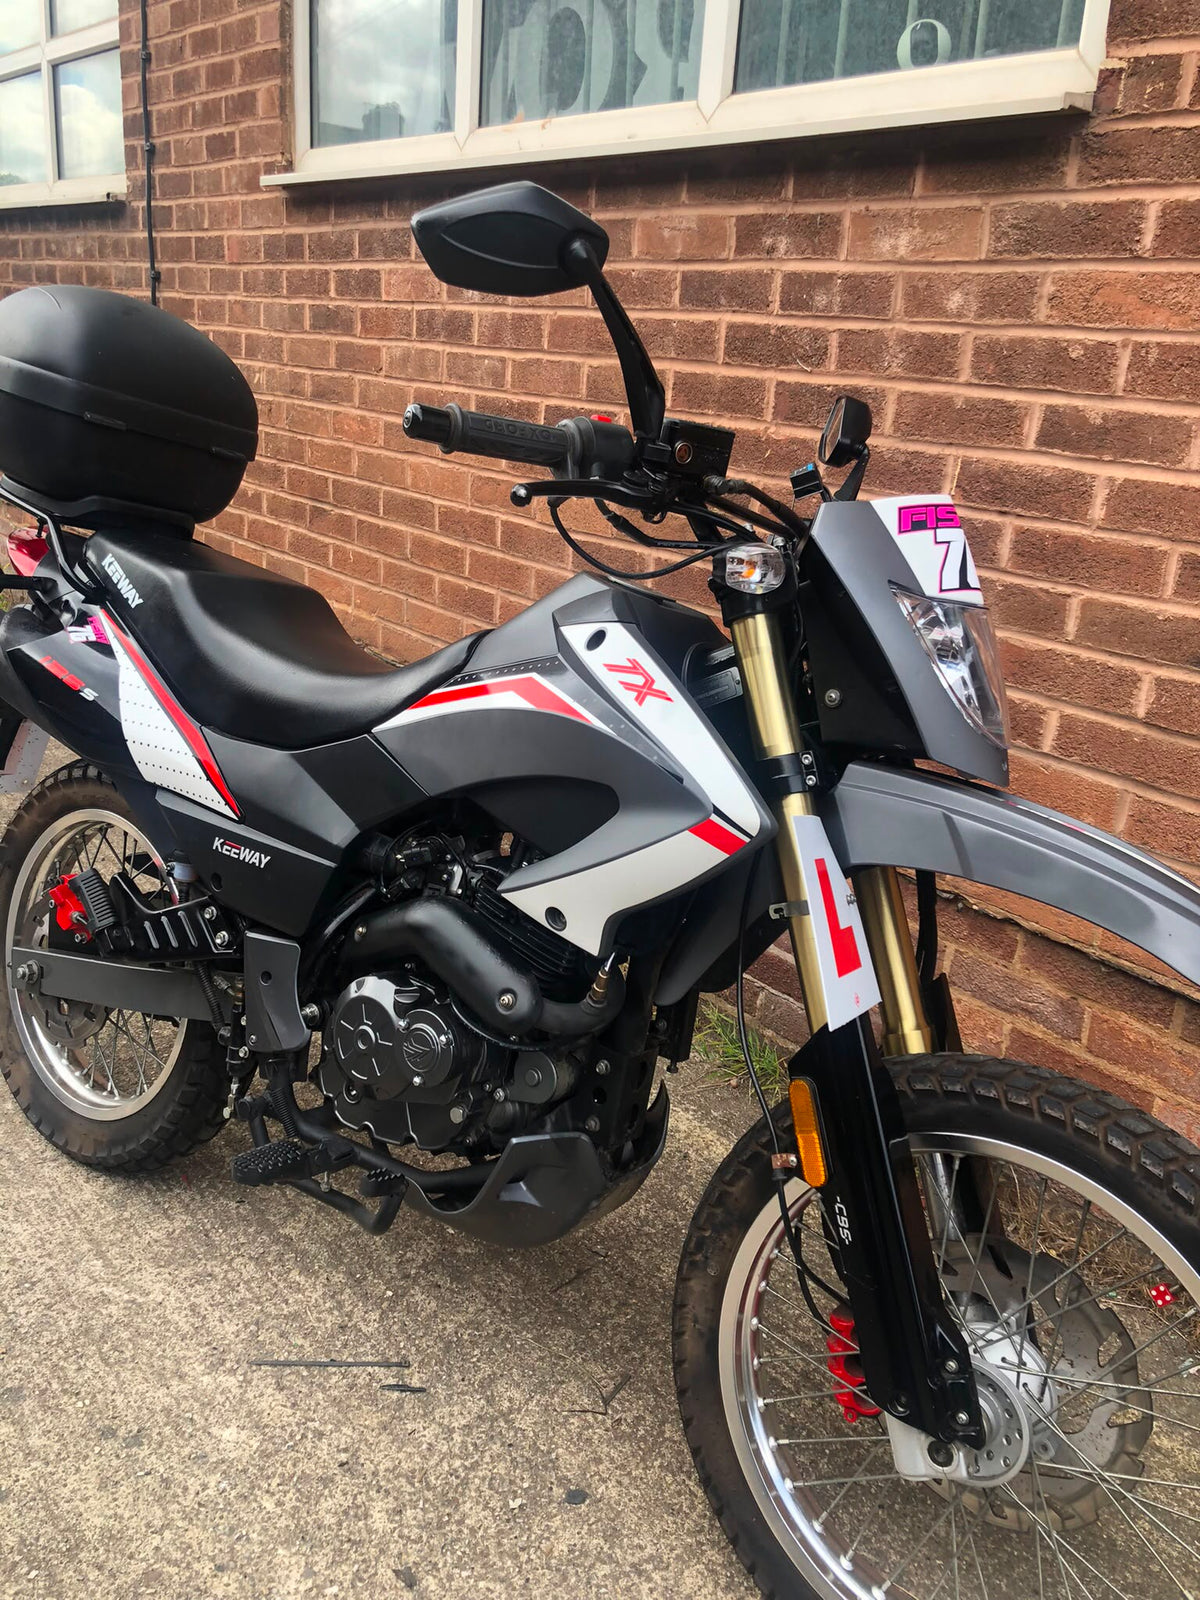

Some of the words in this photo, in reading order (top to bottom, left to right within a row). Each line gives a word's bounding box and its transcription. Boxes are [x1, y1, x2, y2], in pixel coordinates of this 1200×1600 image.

[102, 553, 144, 609] KEEWAY
[602, 657, 674, 707] TX
[212, 837, 271, 869] KEEWAY
[814, 858, 862, 978] L
